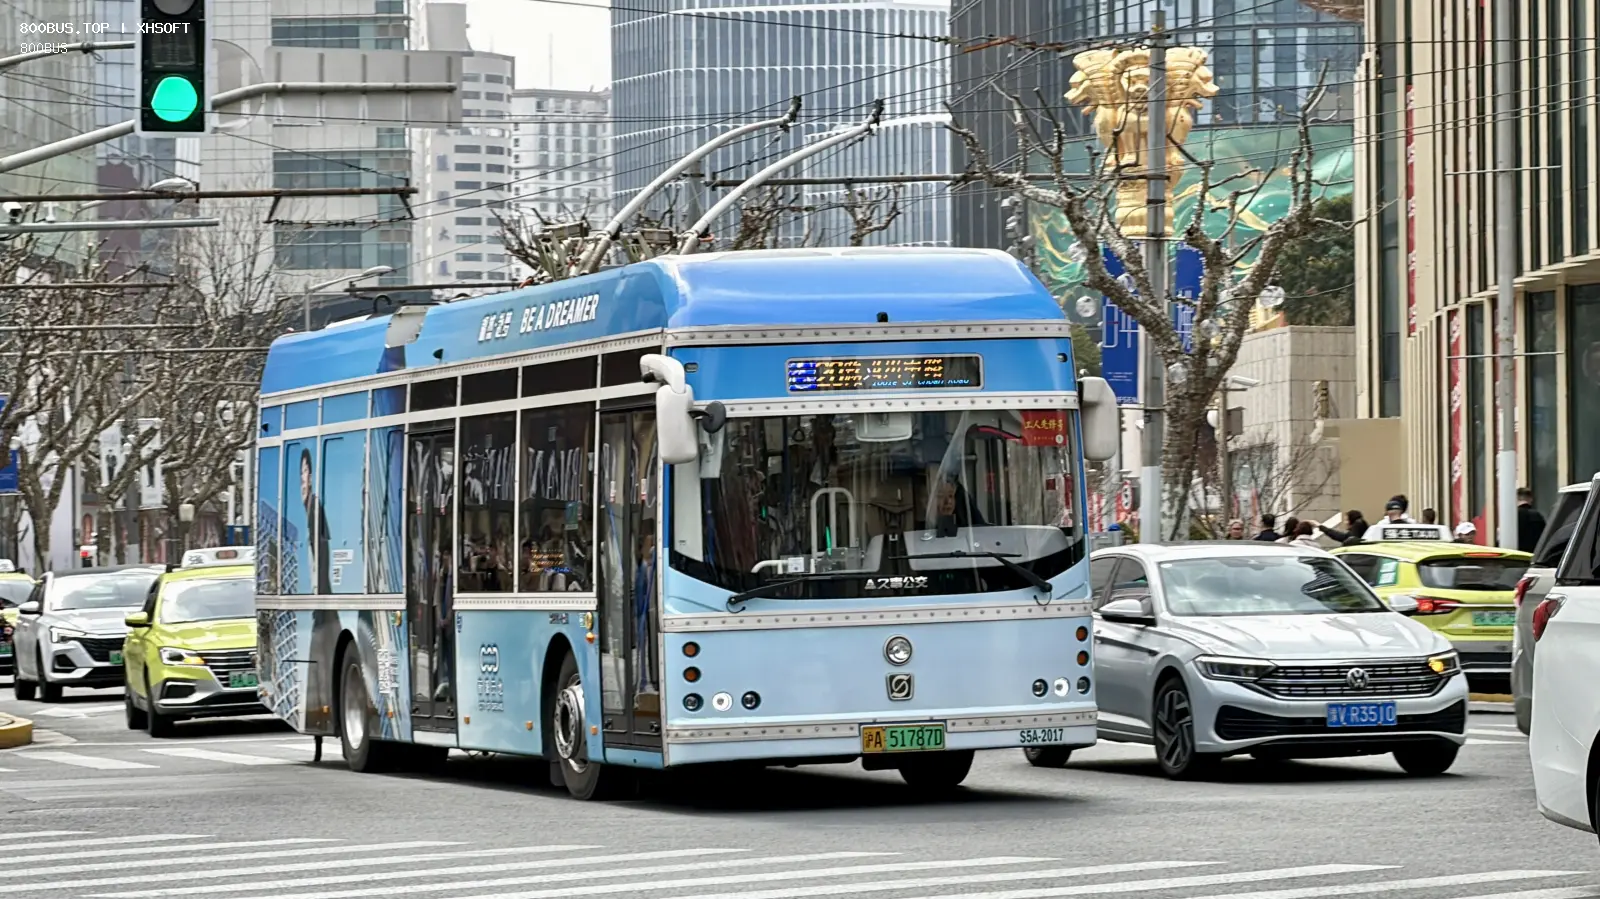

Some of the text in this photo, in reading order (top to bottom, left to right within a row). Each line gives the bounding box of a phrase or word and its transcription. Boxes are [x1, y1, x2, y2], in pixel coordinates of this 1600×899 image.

[519, 306, 537, 334] BE
[534, 304, 546, 331] A
[544, 294, 600, 329] DREAMER
[877, 575, 928, 590] 久事公交
[889, 727, 943, 748] 51787D
[1019, 728, 1064, 744] S5A-2017
